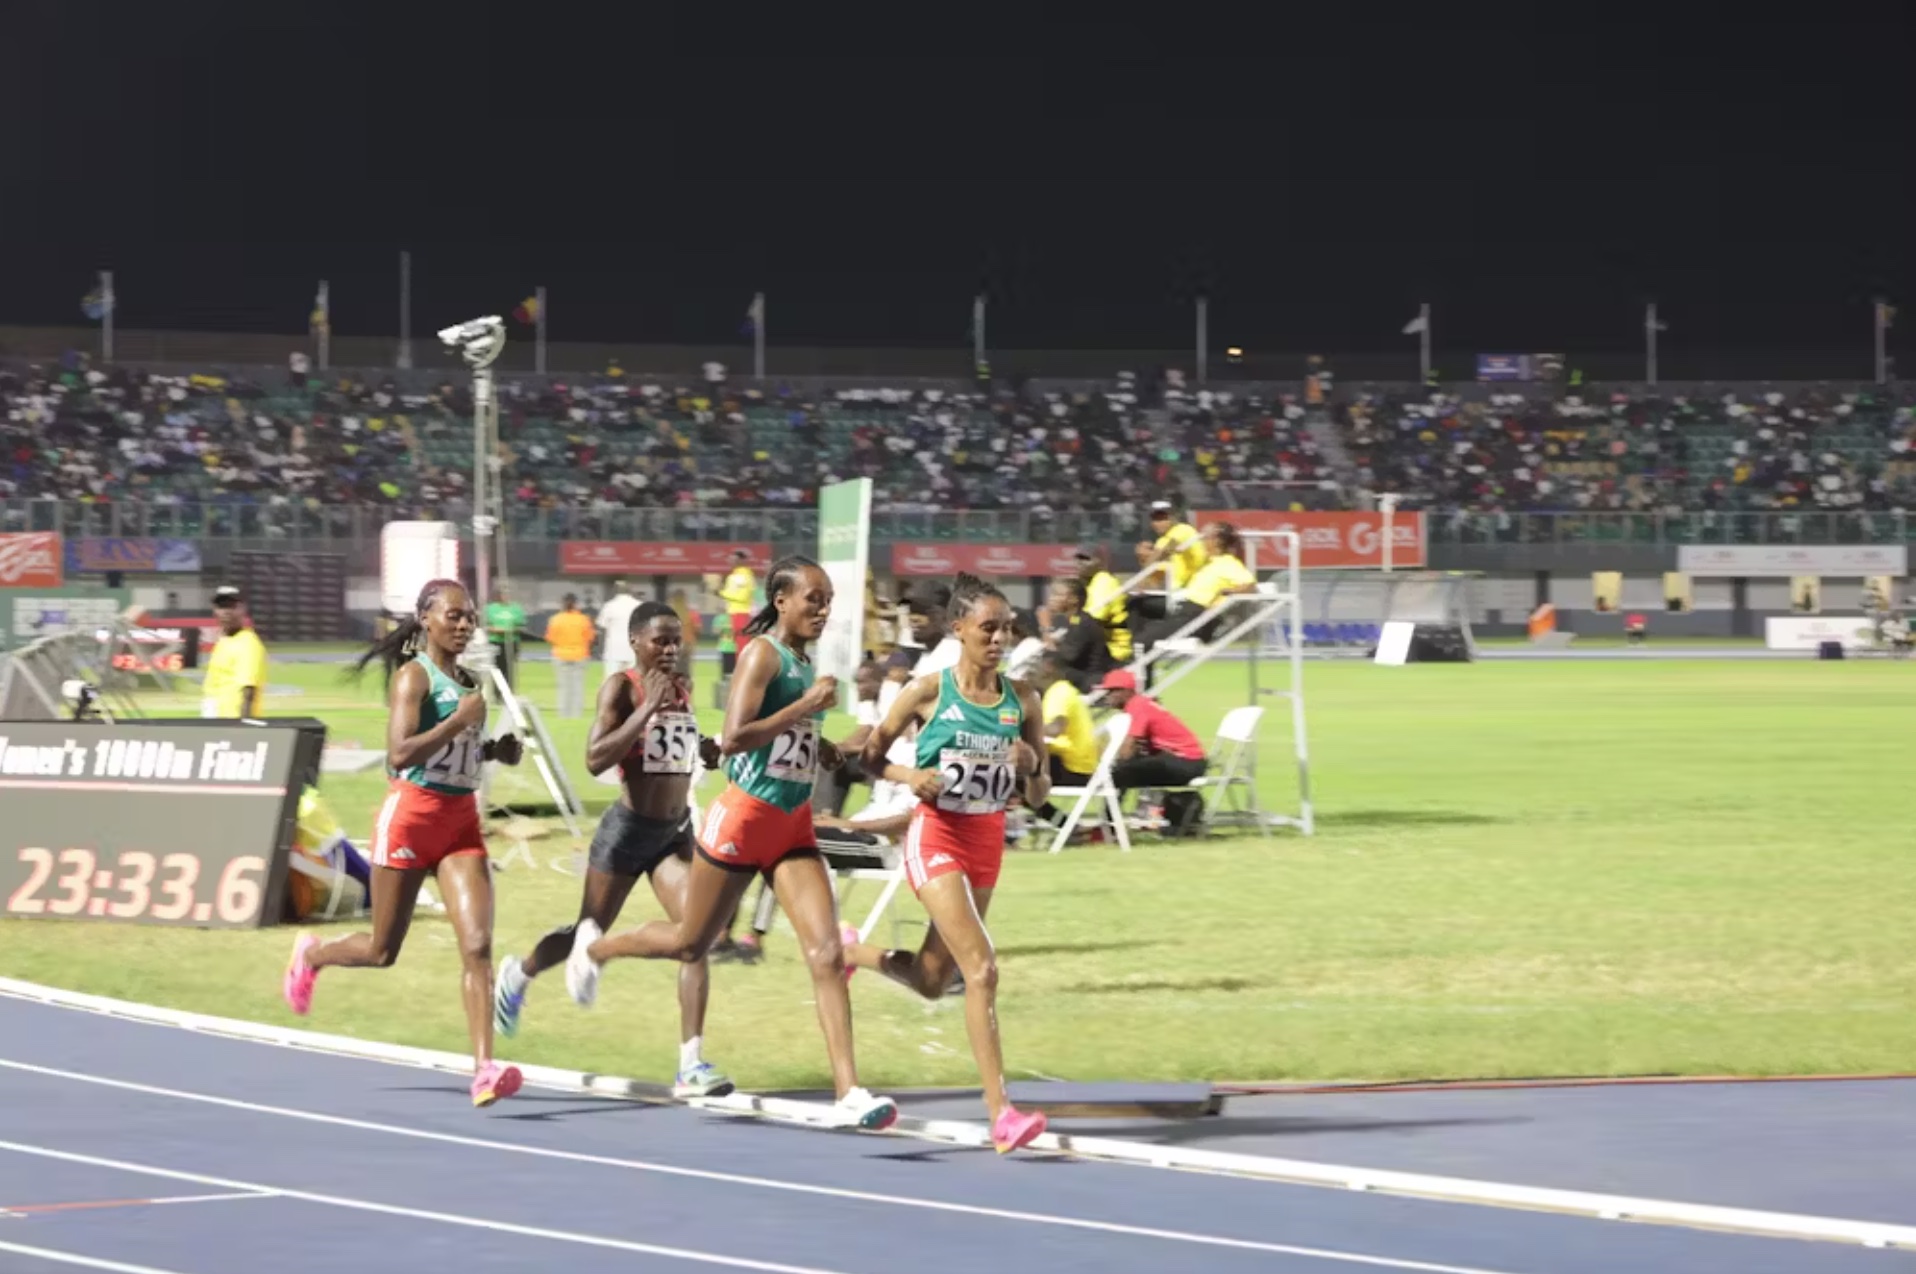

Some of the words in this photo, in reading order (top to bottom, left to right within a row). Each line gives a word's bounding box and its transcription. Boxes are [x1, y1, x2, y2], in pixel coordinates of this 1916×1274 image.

[955, 730, 1010, 751] ETHIOPIA
[198, 741, 269, 782] Final
[942, 763, 1011, 801] 250
[7, 847, 266, 924] 23:33.6
